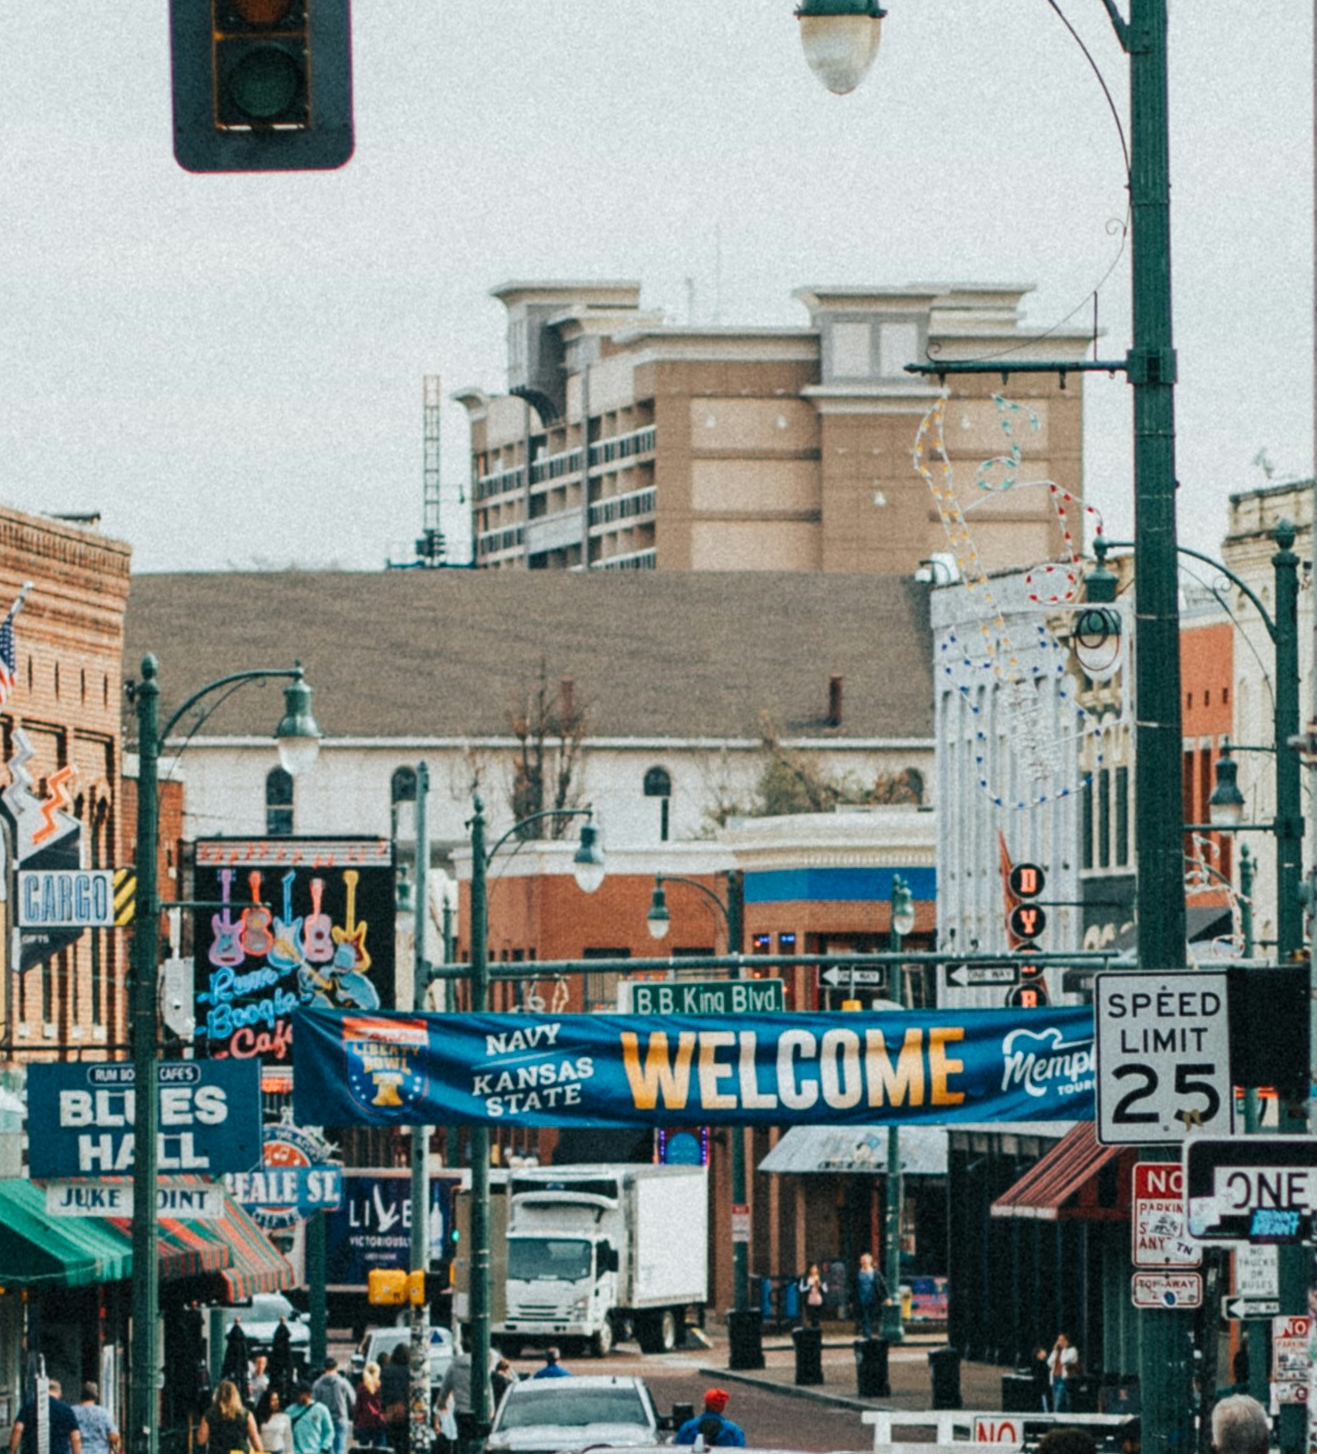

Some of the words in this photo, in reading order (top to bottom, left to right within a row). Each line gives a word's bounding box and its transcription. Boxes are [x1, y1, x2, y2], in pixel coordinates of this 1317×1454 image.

[23, 874, 107, 923] CARGO
[637, 987, 680, 1015] B.B.
[684, 986, 725, 1014] King
[732, 984, 781, 1013] Blvd.
[1108, 991, 1221, 1018] SPEED
[352, 1043, 420, 1057] LIBERTY
[485, 1023, 561, 1056] NAVY
[1120, 1027, 1208, 1054] LIMIT
[94, 1068, 119, 1082] RUM
[363, 1056, 412, 1075] BOWL
[471, 1057, 594, 1096] KANSAS
[620, 1027, 965, 1110] WELCOME
[485, 1083, 582, 1117] STATE
[1111, 1063, 1221, 1125] 25
[59, 1188, 121, 1208] JUKE
[157, 1190, 210, 1210] OINT
[1226, 1171, 1309, 1210] ONE
[1177, 1241, 1193, 1255] TN
[977, 1422, 1017, 1443] NO
